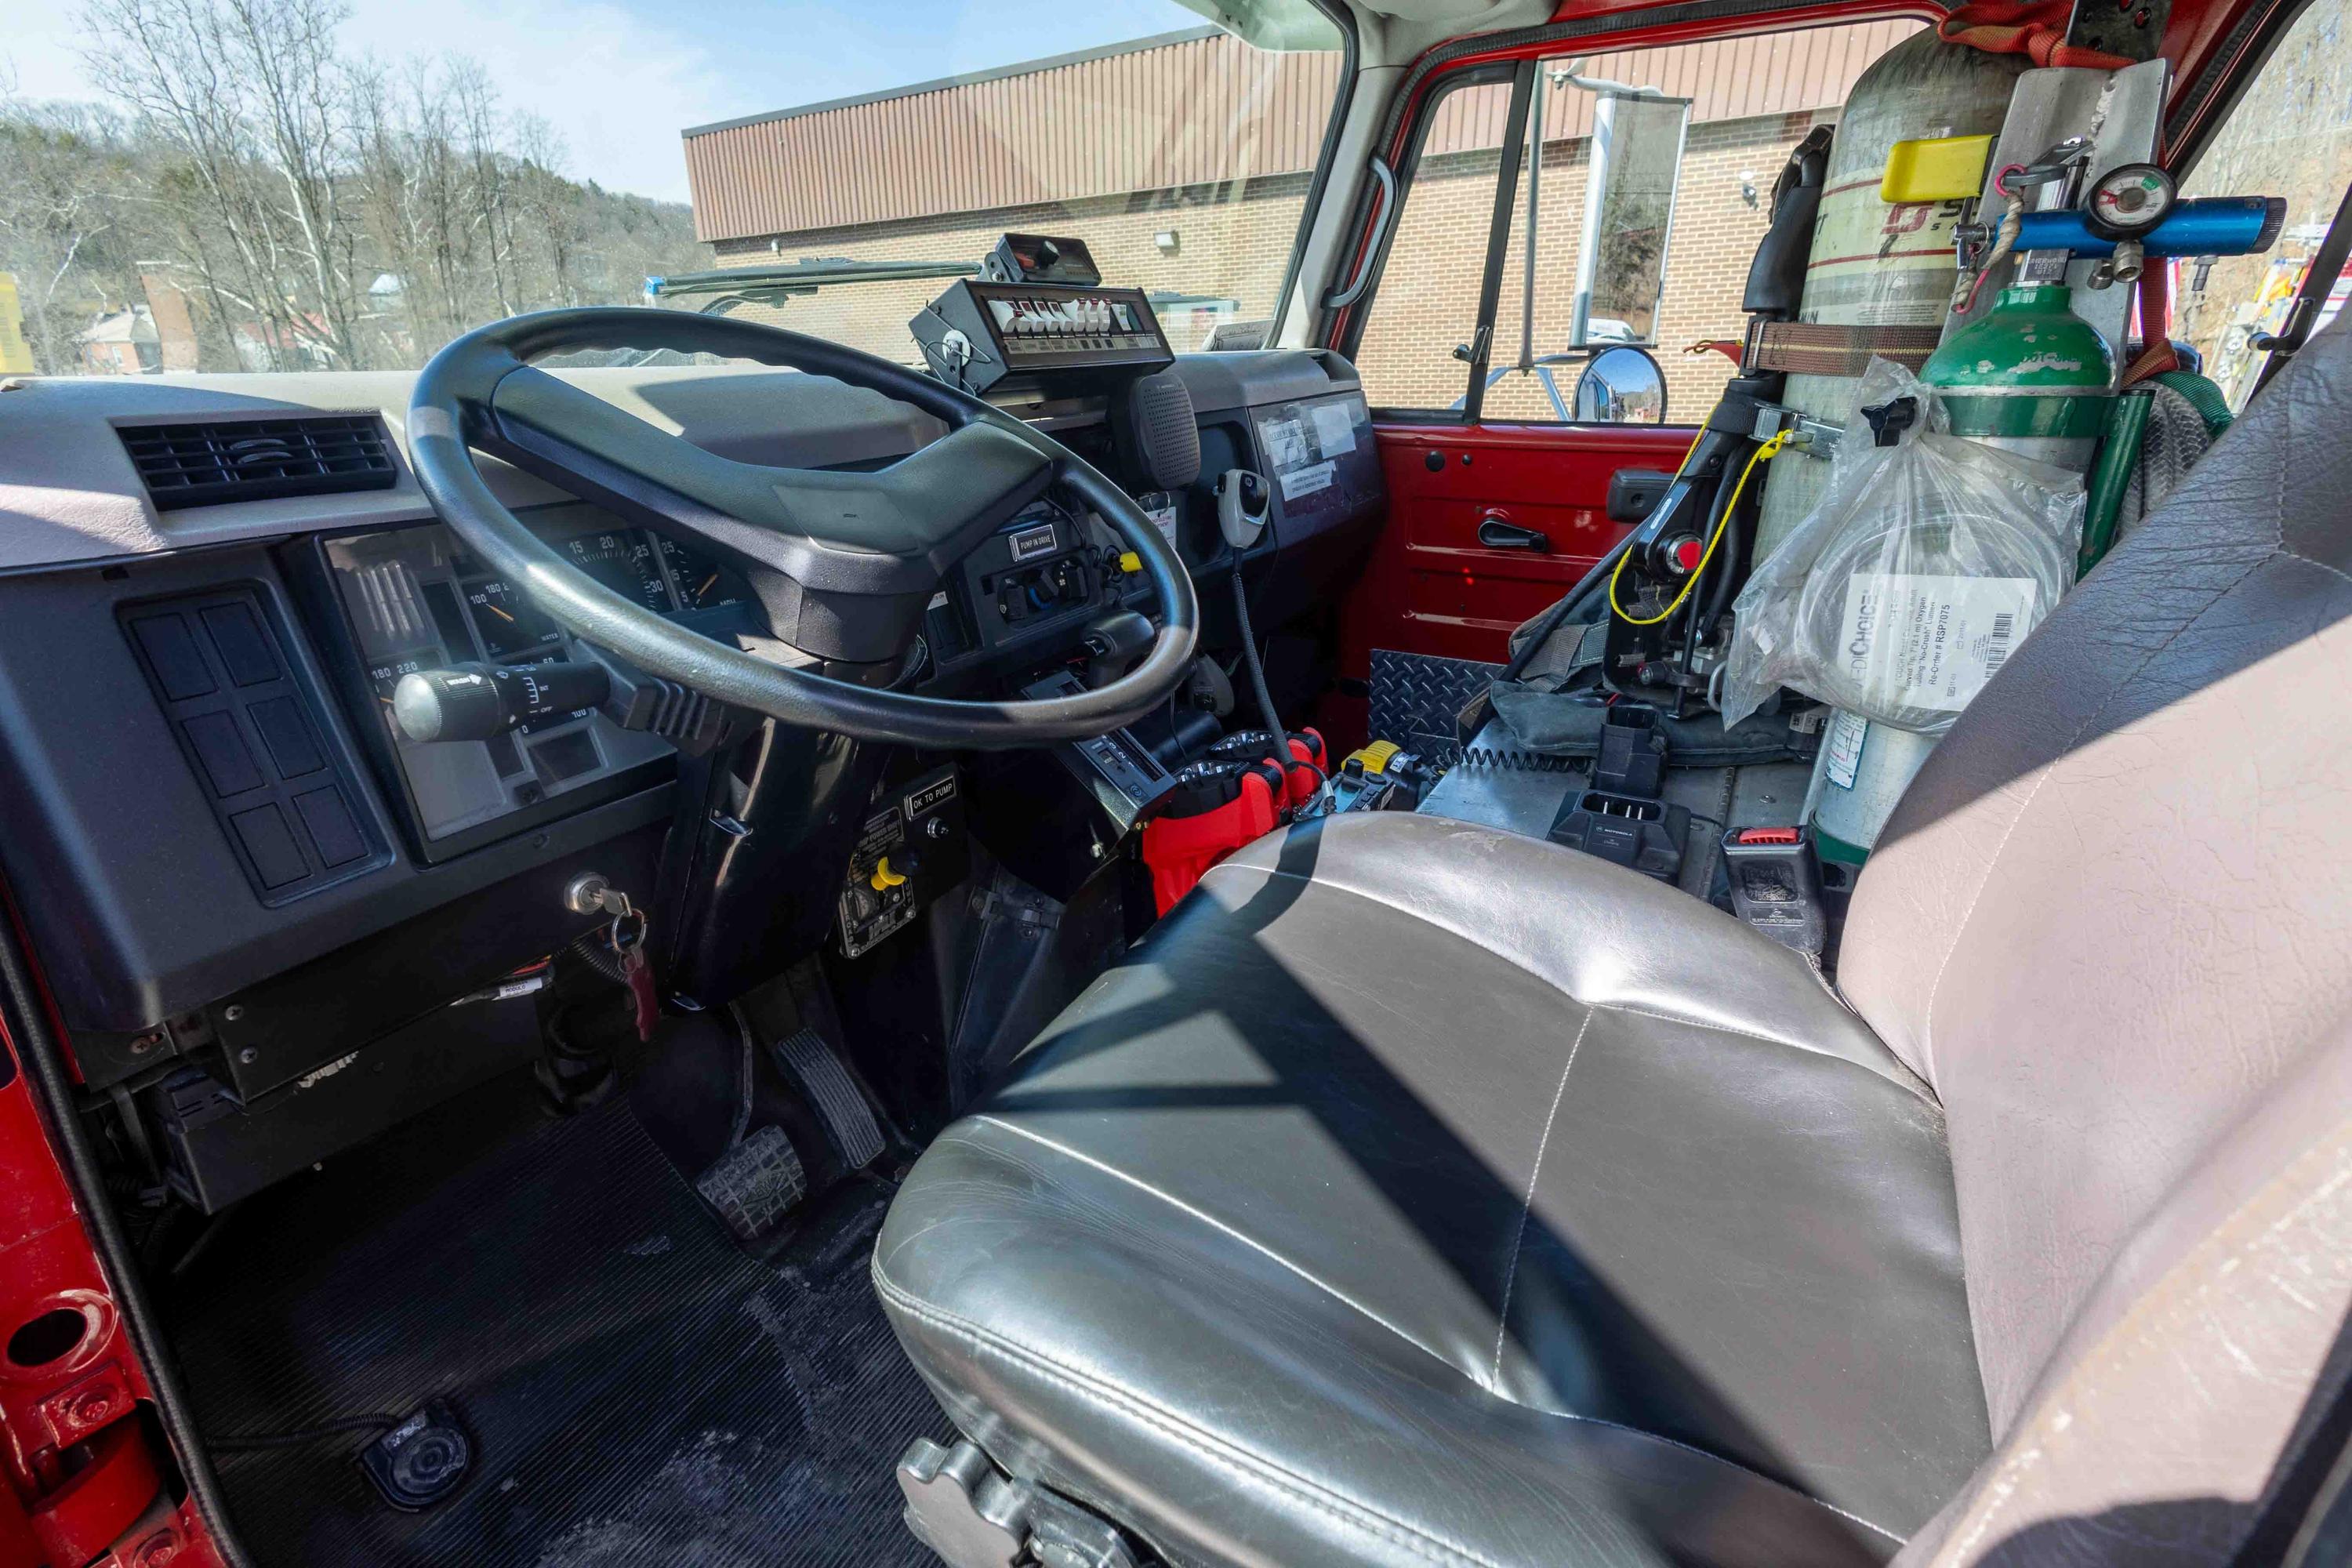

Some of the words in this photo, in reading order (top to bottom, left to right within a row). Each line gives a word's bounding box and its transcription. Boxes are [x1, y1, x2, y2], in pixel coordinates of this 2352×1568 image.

[569, 540, 584, 554] 15
[599, 535, 615, 550] 20
[661, 541, 675, 554] 25
[1020, 540, 1033, 550] PUMP
[1038, 535, 1051, 545] DRIVE
[635, 545, 649, 557] 25
[485, 583, 502, 593] 180
[650, 579, 663, 593] 30
[470, 593, 487, 604] 100
[1915, 596, 1927, 622] Oxygen
[1928, 651, 1942, 685] Re-Order
[1935, 603, 1951, 643] RSP7075
[372, 667, 391, 680] 180
[397, 662, 418, 675] 220
[521, 724, 529, 734] 0
[1109, 742, 1117, 750] 3
[1117, 751, 1127, 760] 2
[913, 798, 923, 809] OK
[925, 793, 934, 803] TO
[935, 783, 953, 798] PUMP
